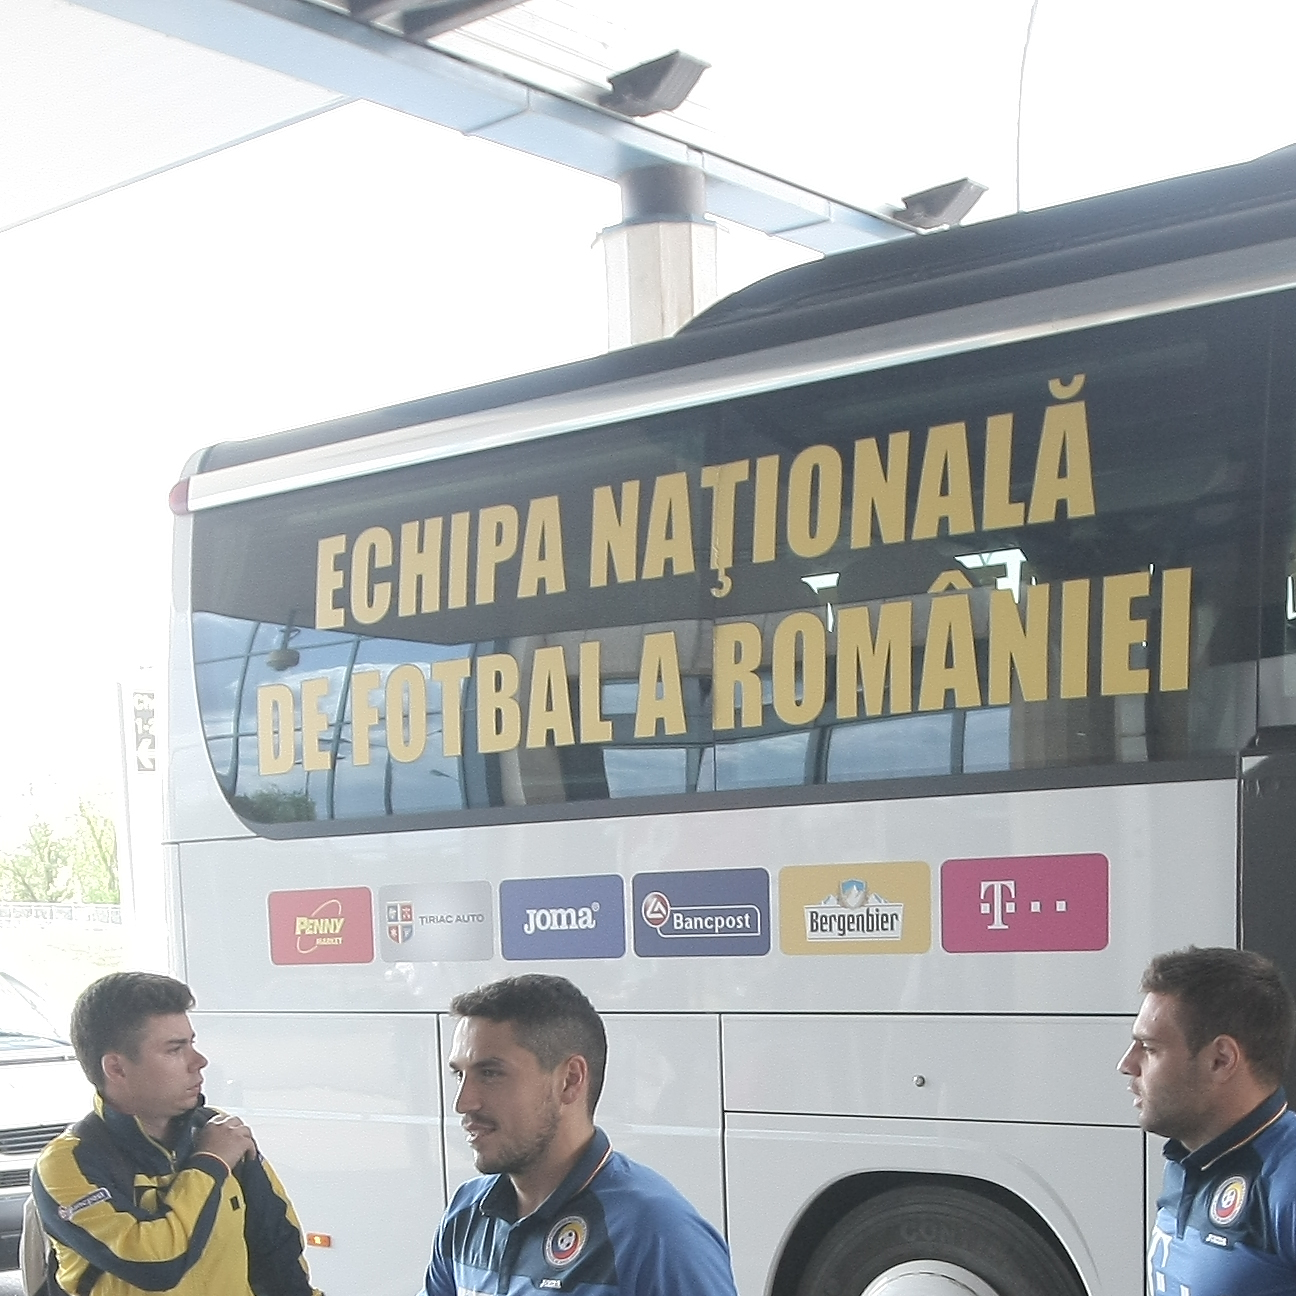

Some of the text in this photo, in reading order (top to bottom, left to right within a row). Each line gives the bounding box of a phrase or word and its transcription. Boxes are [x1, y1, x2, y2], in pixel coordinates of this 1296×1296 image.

[315, 495, 567, 630] ECHIPA
[257, 567, 1192, 776] DE FOTBAL A ROMÂNIEI
[295, 916, 345, 935] PENNY
[455, 913, 485, 923] AUTO
[672, 912, 752, 934] Bancpost
[809, 907, 899, 937] Bergenbier
